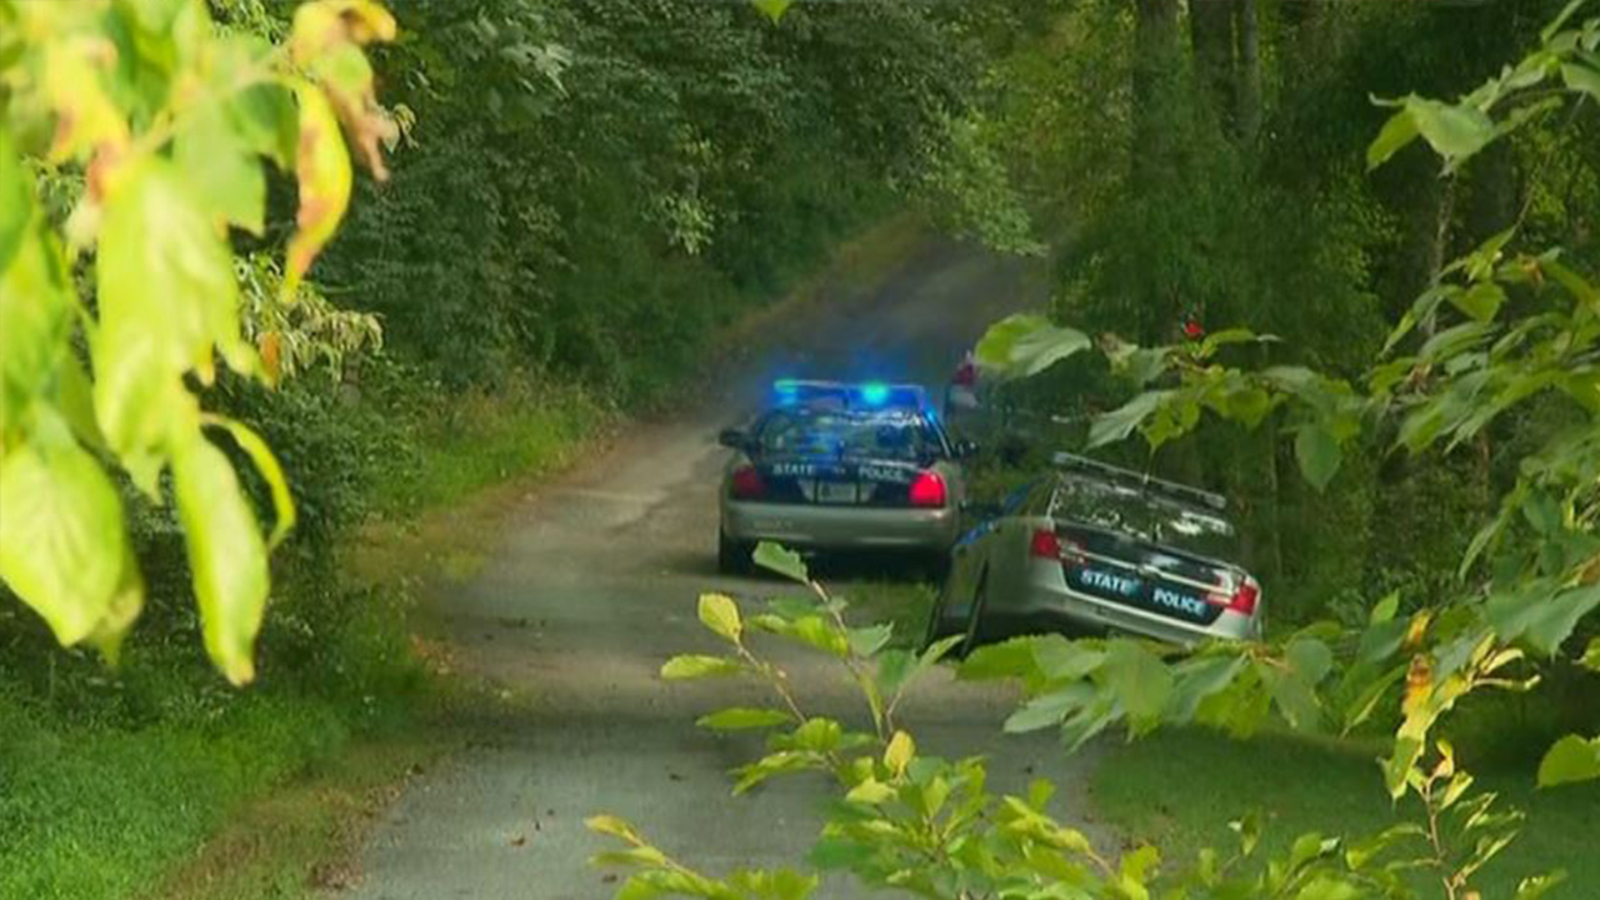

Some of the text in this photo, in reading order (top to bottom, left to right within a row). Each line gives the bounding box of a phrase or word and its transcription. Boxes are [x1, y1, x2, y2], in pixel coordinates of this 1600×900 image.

[773, 463, 903, 481] STATE POLICE
[1080, 568, 1205, 615] STATE POLICE
